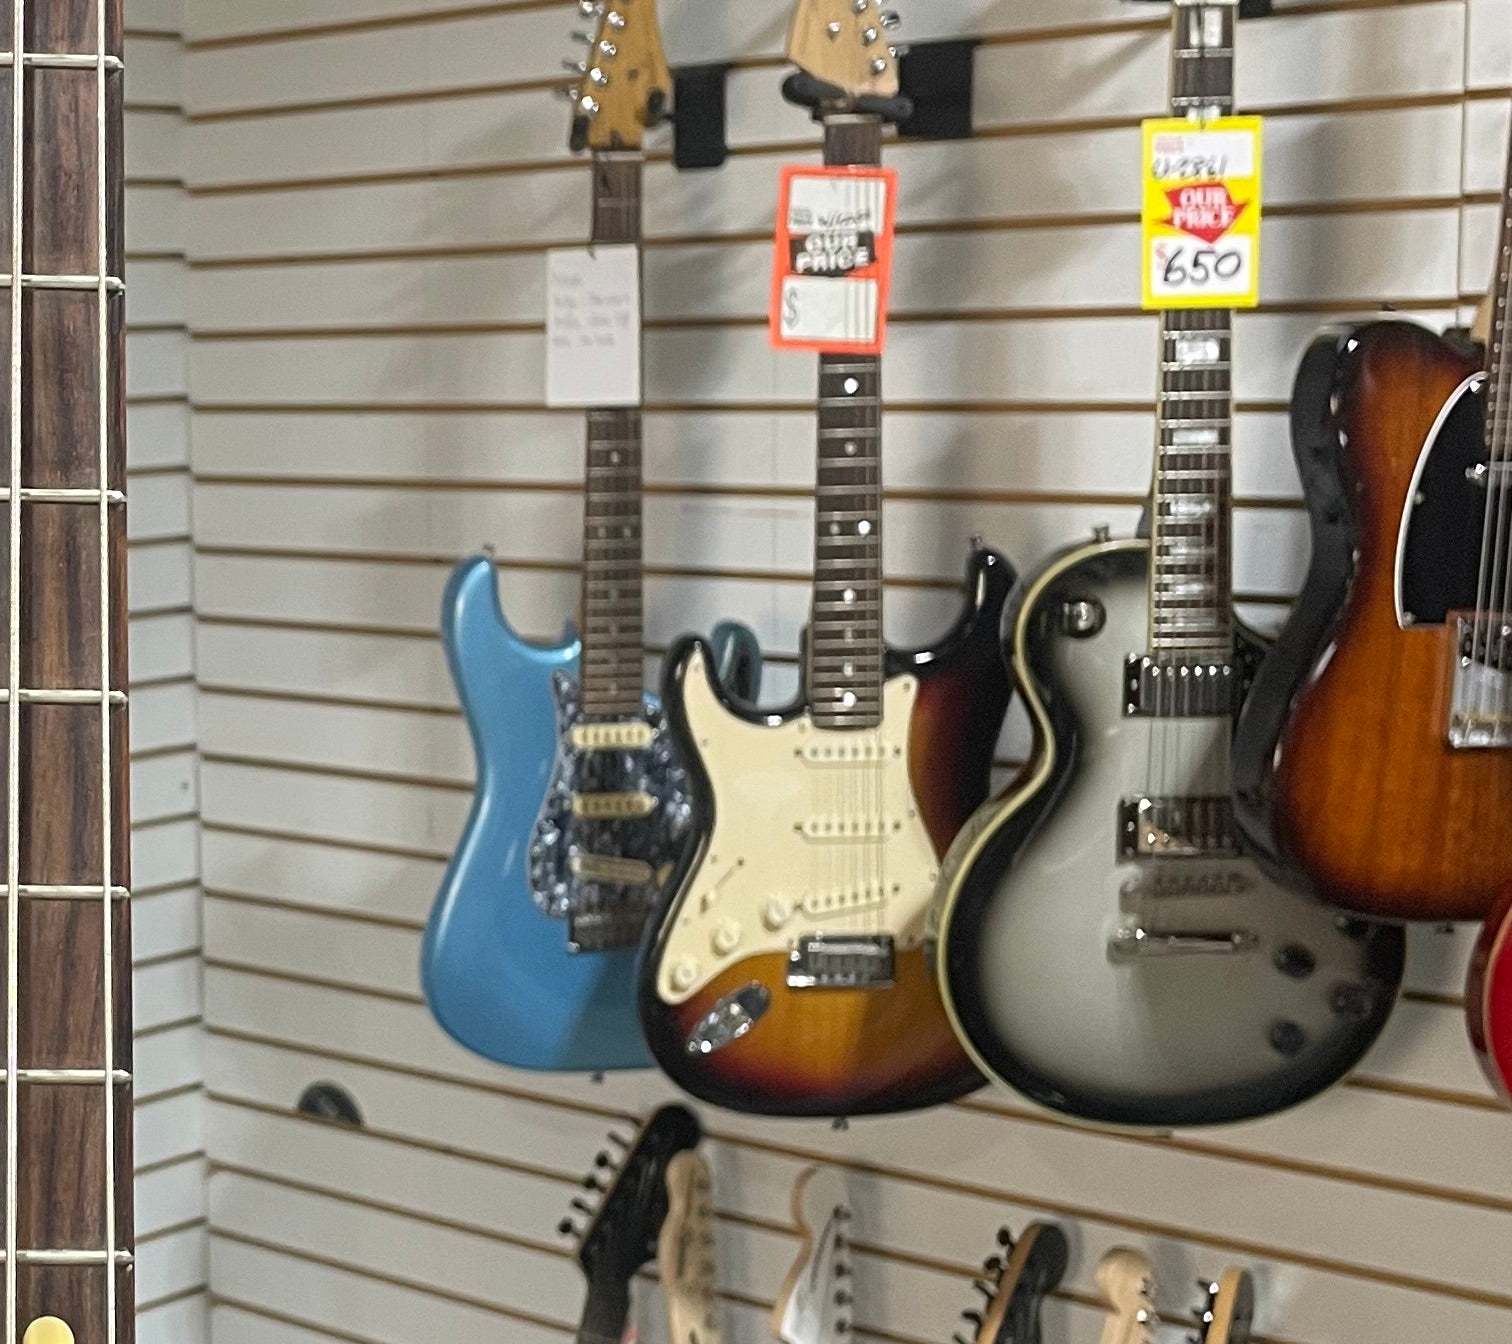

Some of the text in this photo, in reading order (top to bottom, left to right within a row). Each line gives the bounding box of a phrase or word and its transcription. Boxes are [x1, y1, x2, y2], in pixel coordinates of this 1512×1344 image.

[1179, 185, 1230, 208] OUR
[1173, 205, 1239, 231] PRICE
[804, 230, 858, 256] OUR
[795, 245, 869, 274] PRICE
